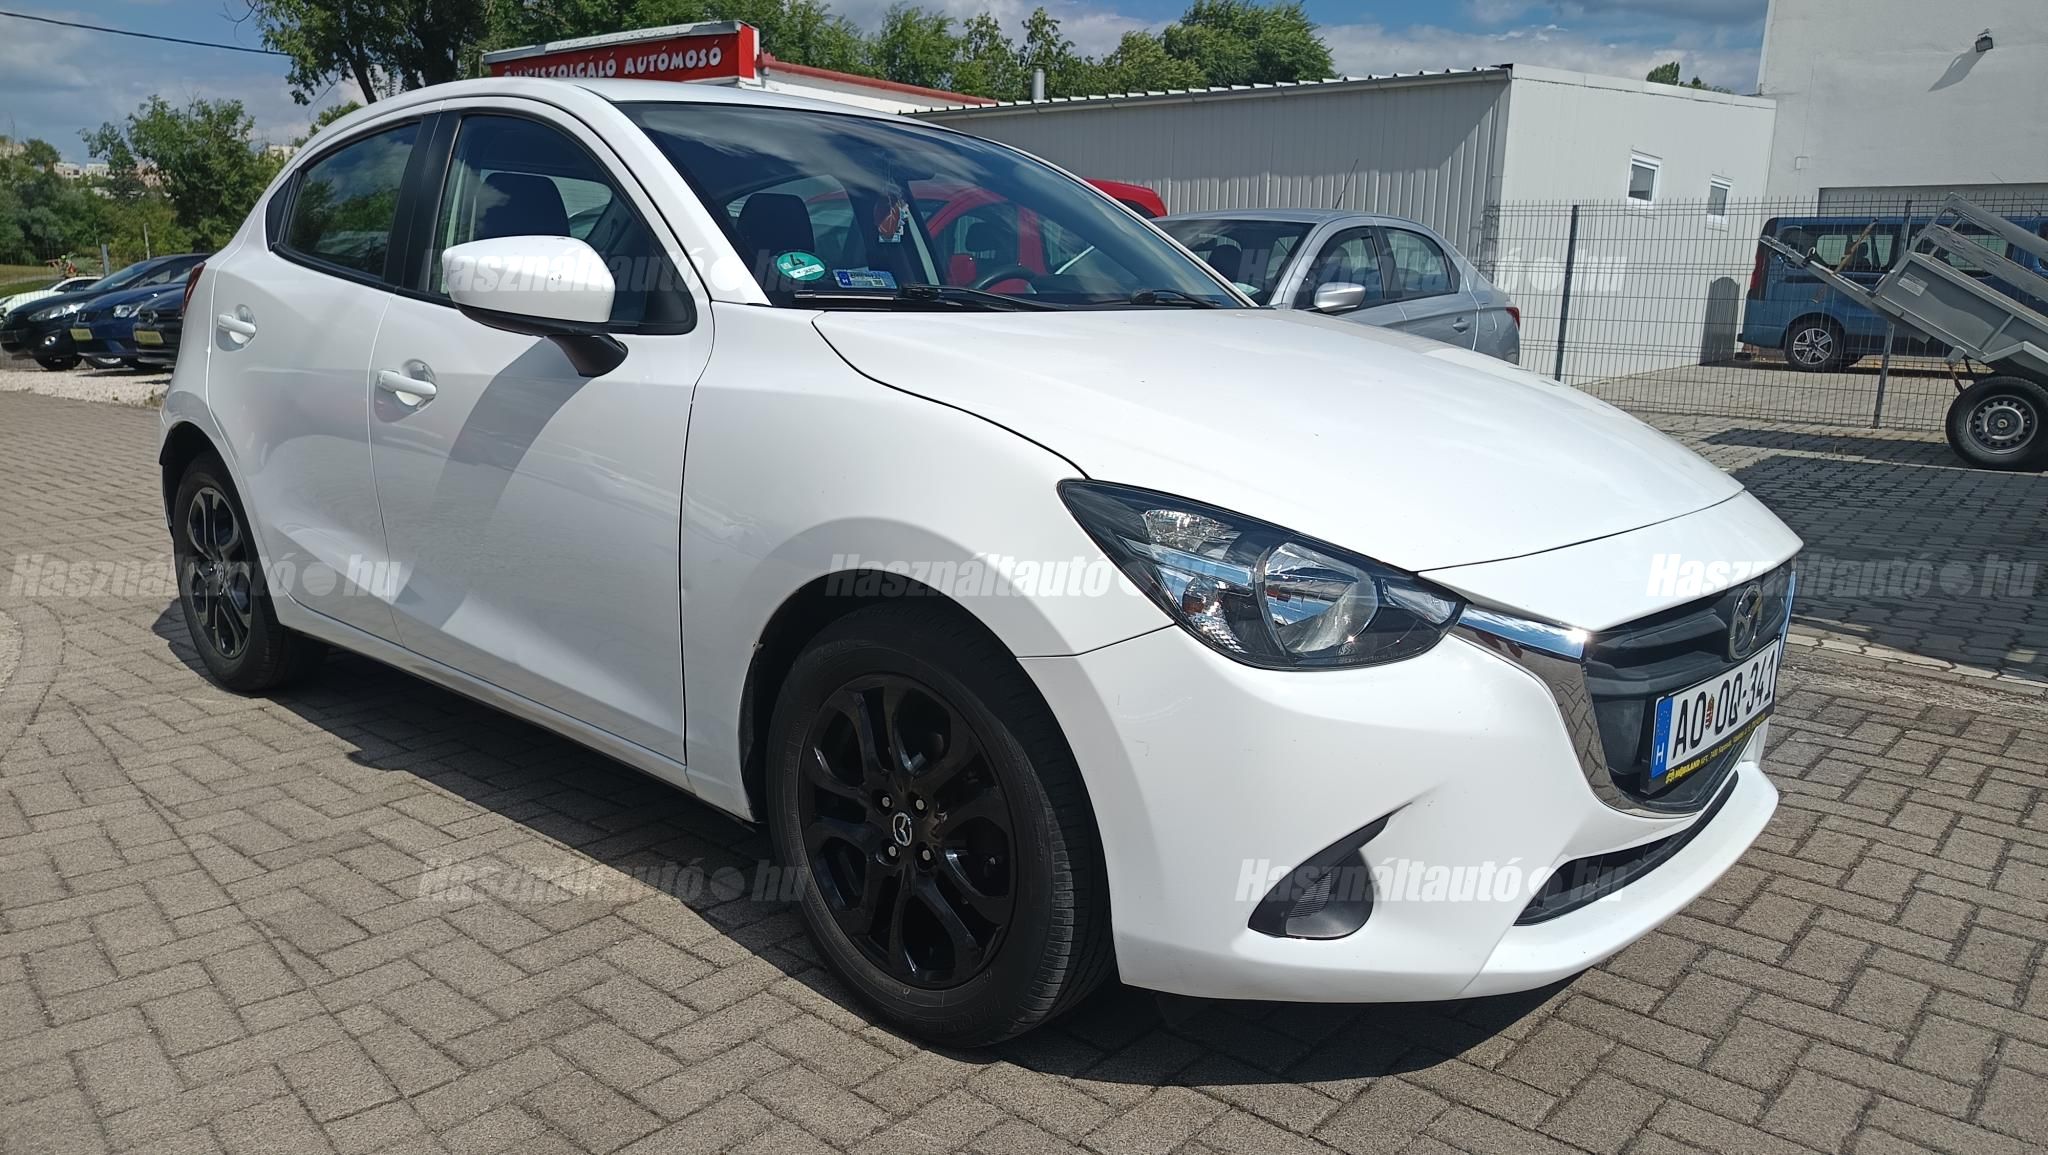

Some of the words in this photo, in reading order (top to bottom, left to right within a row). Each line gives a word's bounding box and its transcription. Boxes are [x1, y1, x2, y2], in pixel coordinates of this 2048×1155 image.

[624, 40, 722, 75] AUTÓMOSÓ
[789, 254, 806, 266] 4
[1672, 691, 1707, 760] AO
